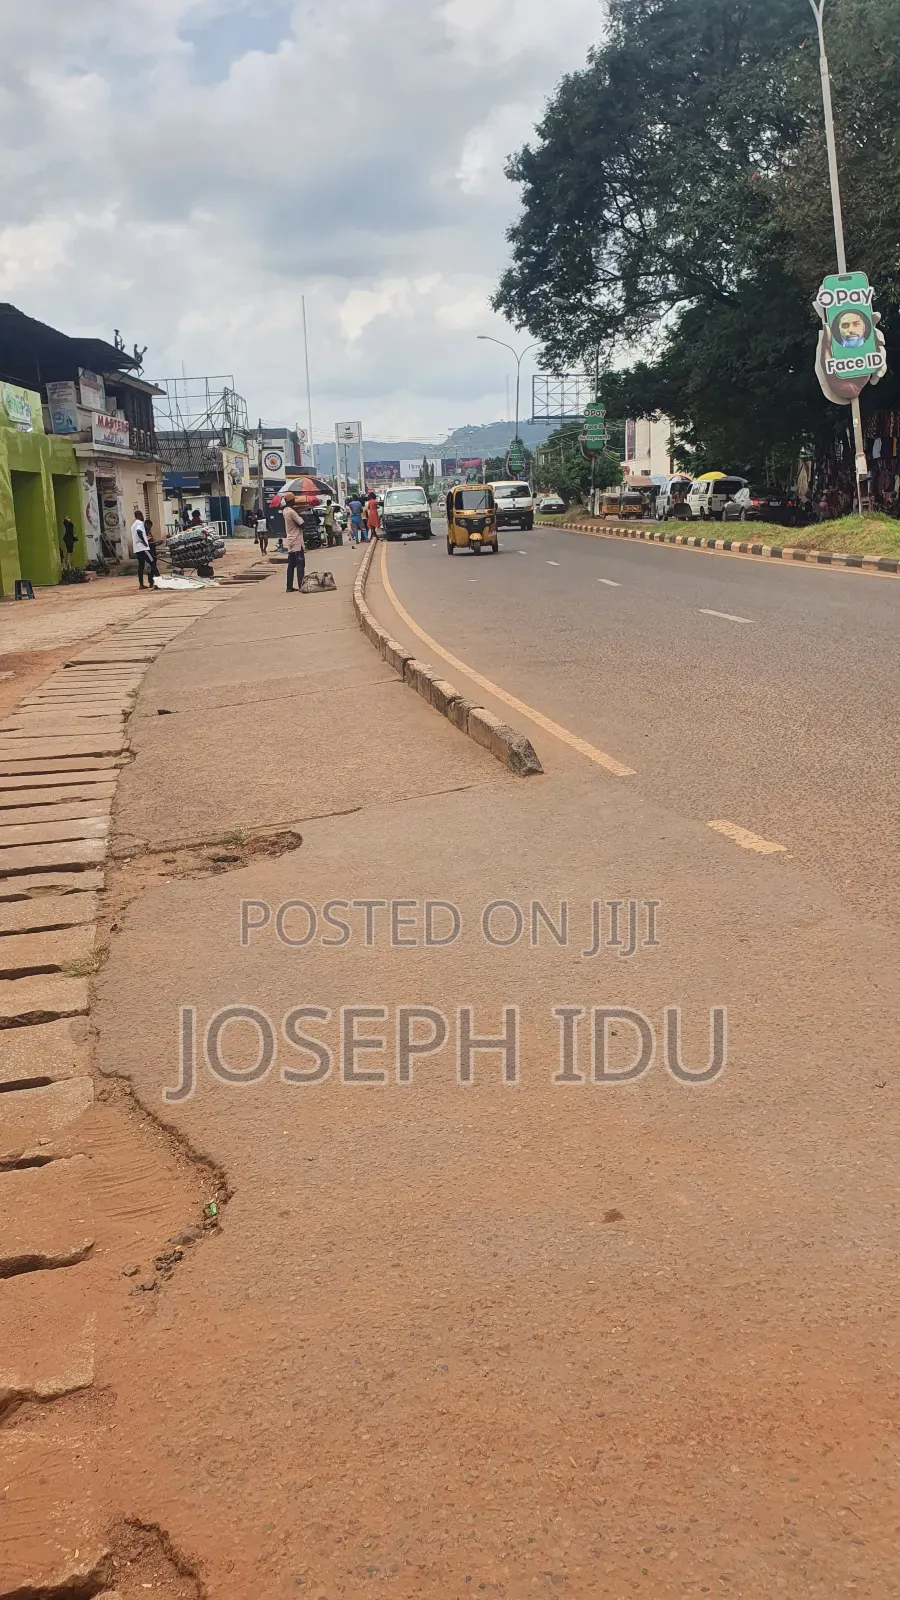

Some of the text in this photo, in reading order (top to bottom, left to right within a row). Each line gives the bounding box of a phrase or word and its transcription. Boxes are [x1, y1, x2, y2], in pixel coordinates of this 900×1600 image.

[818, 288, 873, 307] OPay
[827, 354, 883, 373] Face ID
[584, 409, 606, 418] OPay
